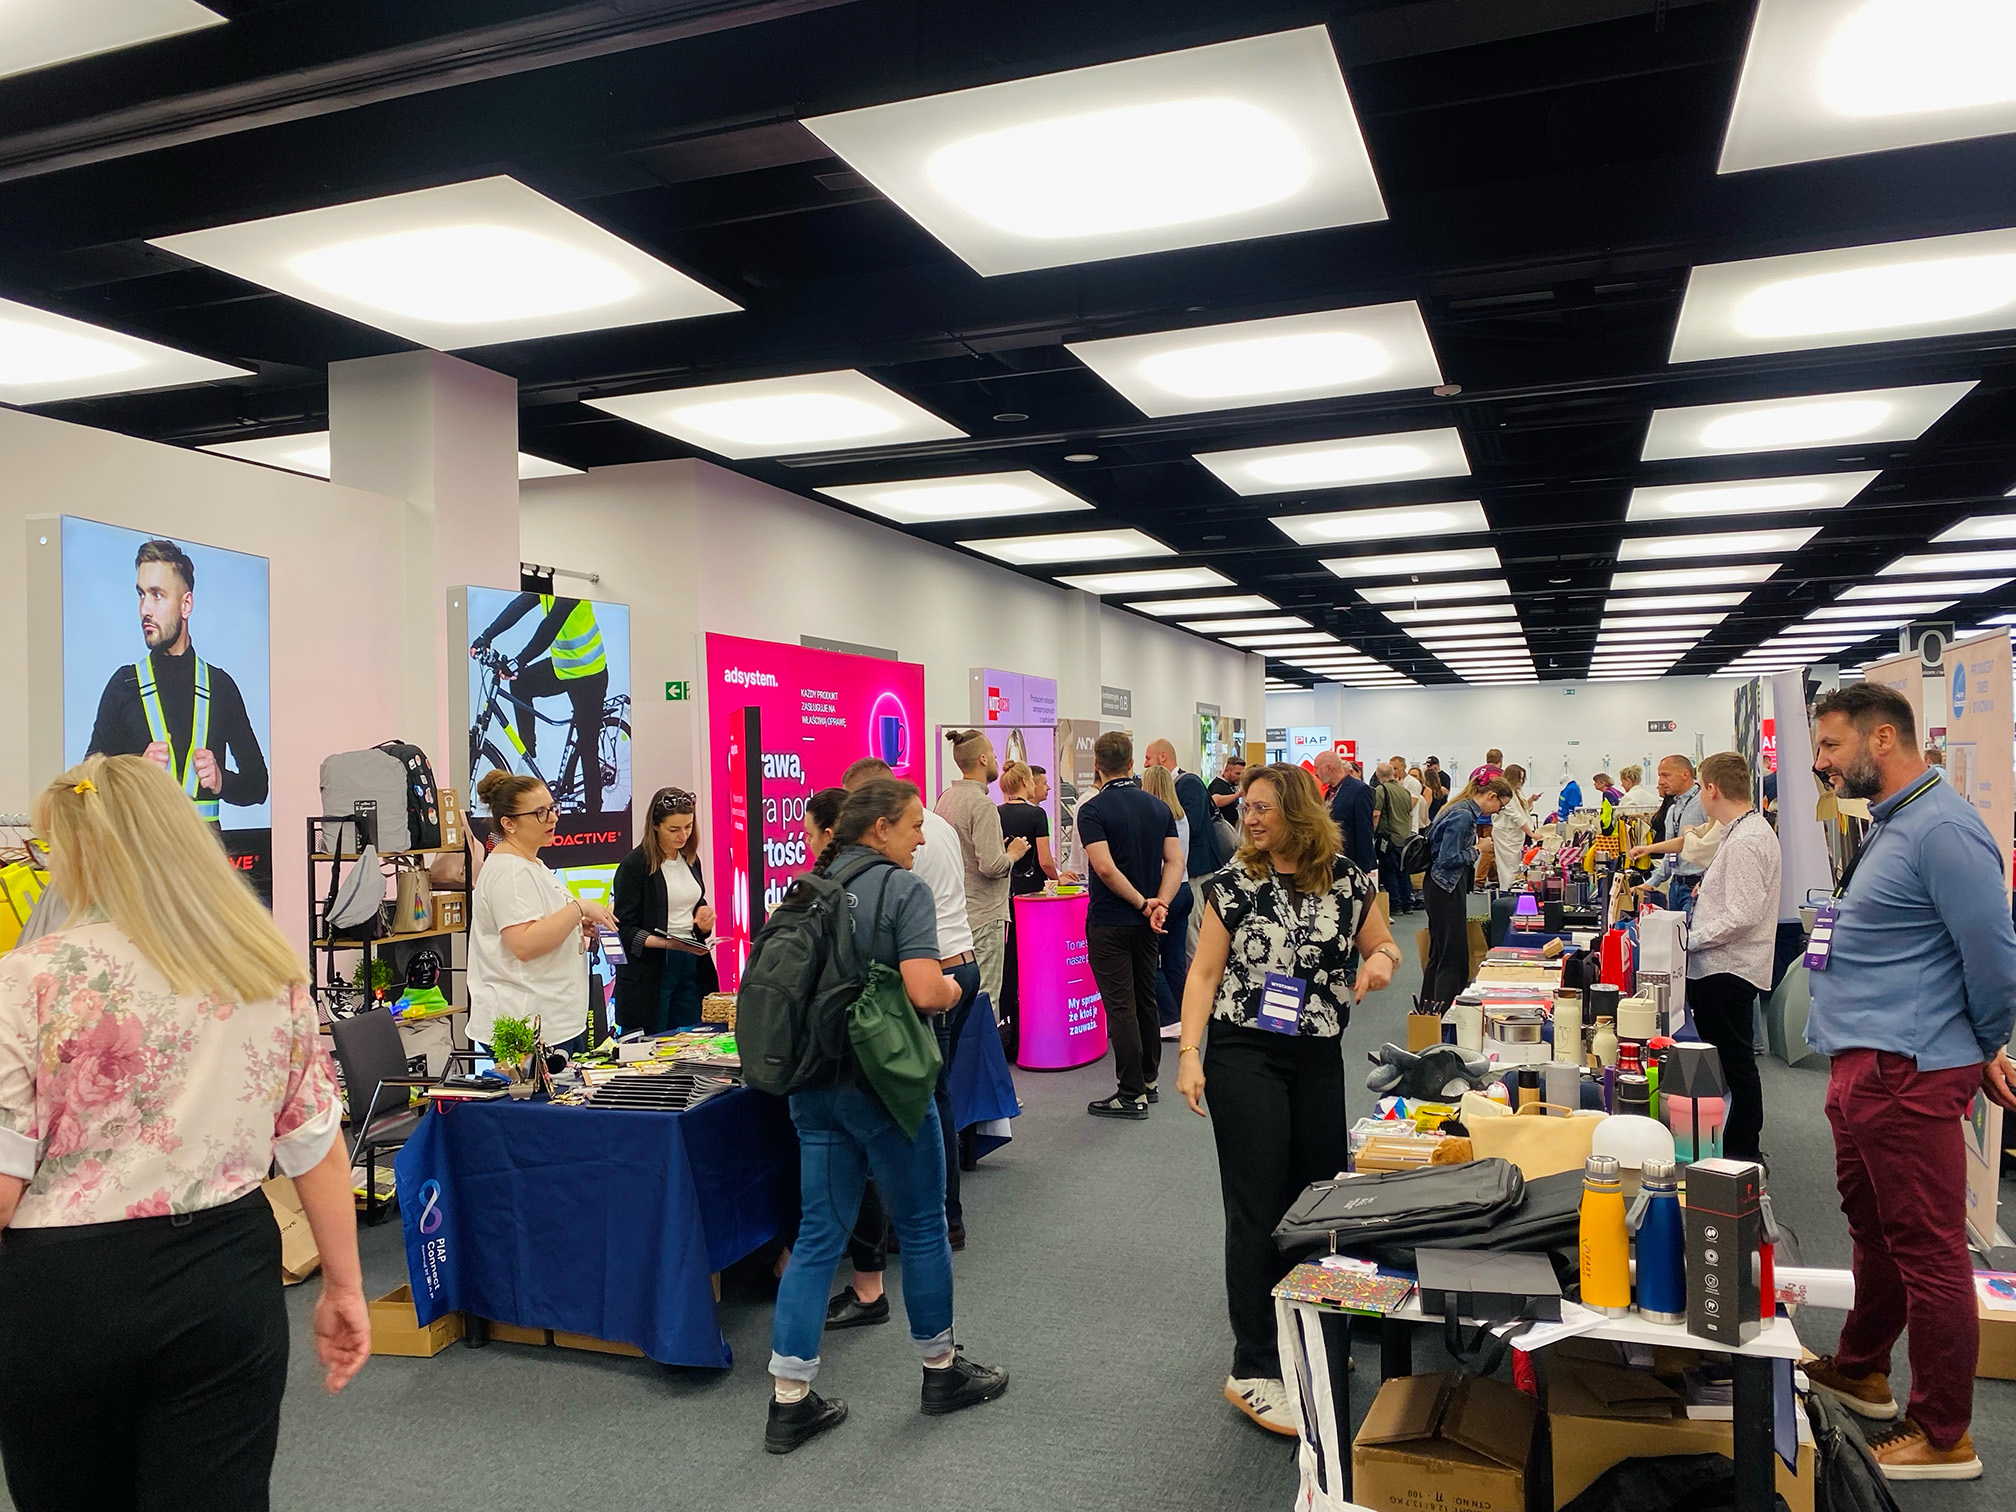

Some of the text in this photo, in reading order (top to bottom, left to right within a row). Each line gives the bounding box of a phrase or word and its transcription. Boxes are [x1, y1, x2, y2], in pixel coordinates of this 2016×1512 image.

[724, 666, 778, 688] adsystem.
[801, 688, 838, 700] KAŻDY PRODUKT
[1295, 736, 1327, 744] PIAP
[1065, 939, 1085, 951] To nie
[1066, 955, 1085, 966] nasze
[1068, 998, 1080, 1010] My
[587, 1010, 595, 1028] FUN
[1069, 1011, 1078, 1022] że
[1080, 1006, 1092, 1020] ktoś
[1069, 1019, 1097, 1036] zauważa.
[436, 1238, 447, 1263] PIAP
[427, 1241, 440, 1290] Connect
[1390, 1496, 1403, 1504] KG
[1407, 1490, 1422, 1499] 100
[1472, 1501, 1491, 1510] CTN
